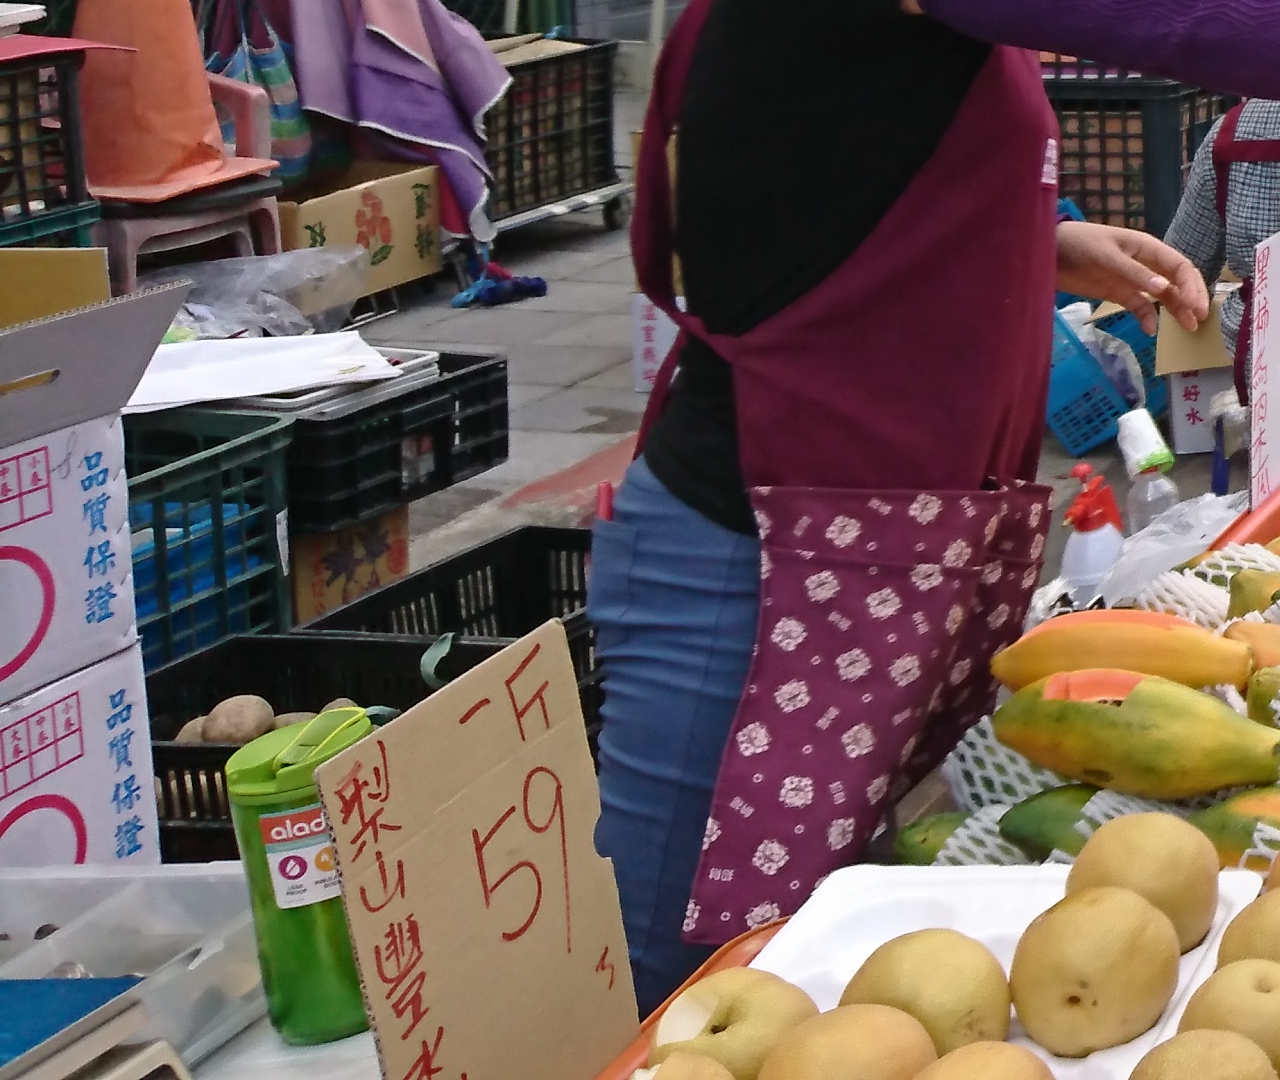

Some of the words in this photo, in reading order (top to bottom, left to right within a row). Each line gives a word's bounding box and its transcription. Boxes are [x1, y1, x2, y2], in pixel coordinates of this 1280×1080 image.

[81, 451, 118, 624] 品質保證
[106, 688, 145, 859] 品質保證
[458, 643, 550, 742] 一斤
[472, 766, 571, 954] 59
